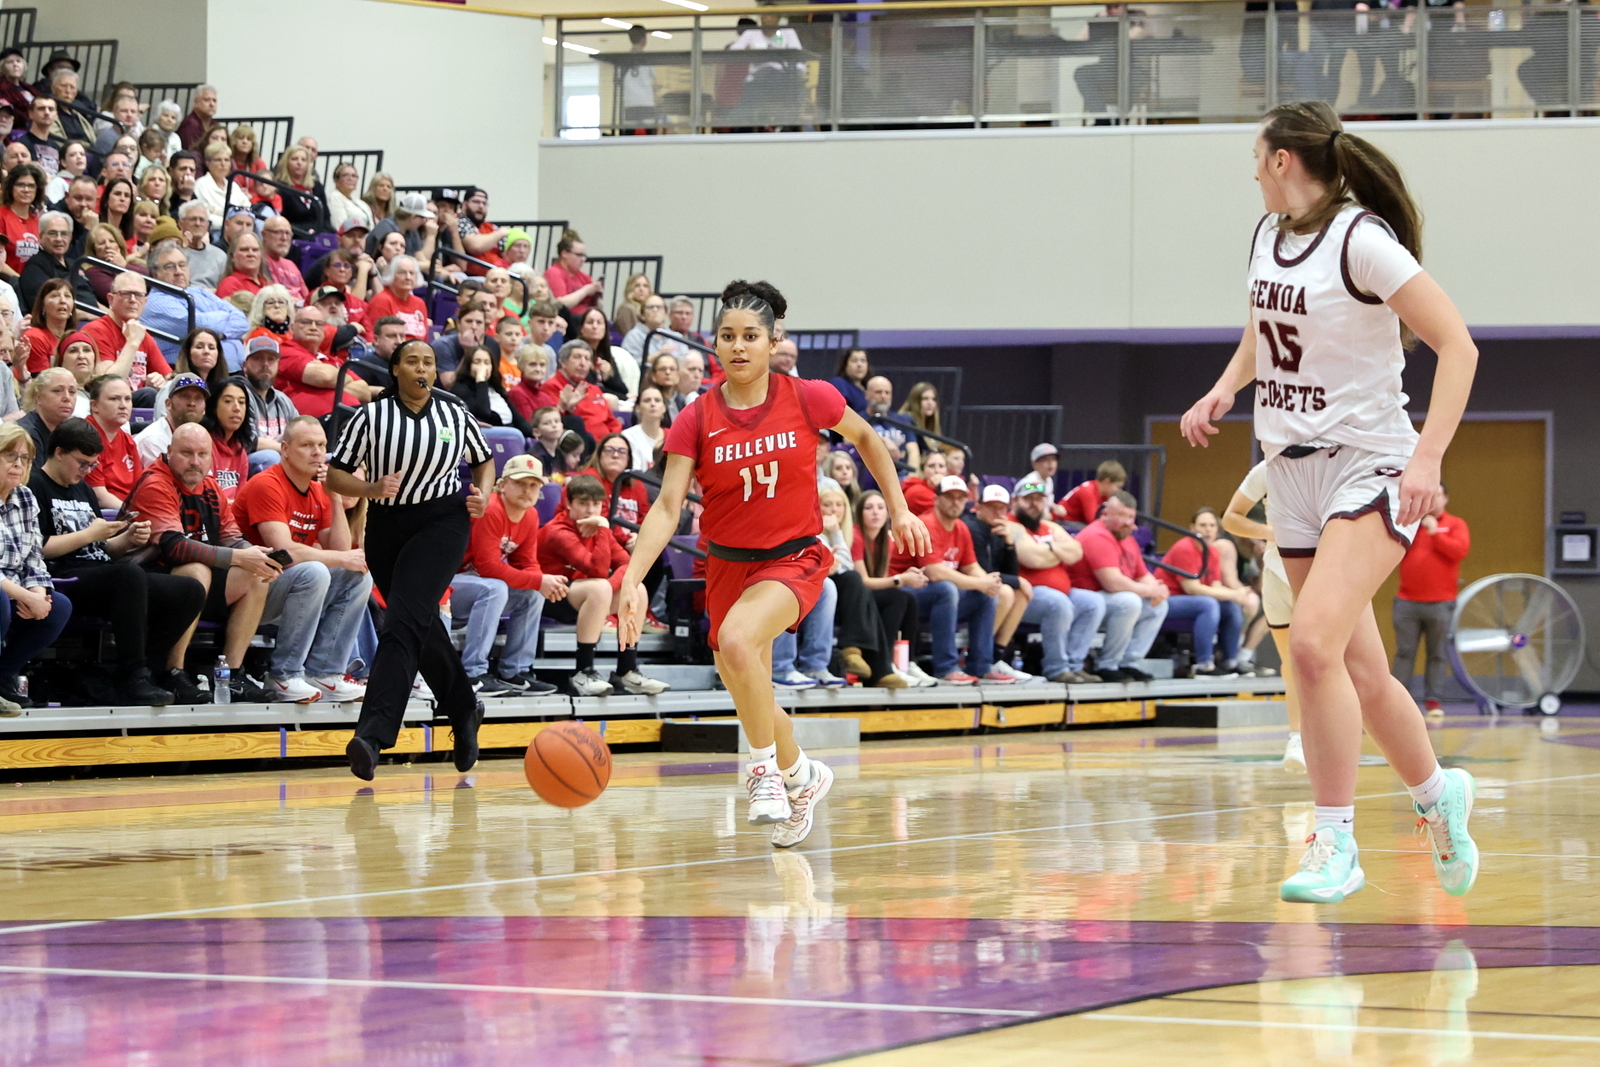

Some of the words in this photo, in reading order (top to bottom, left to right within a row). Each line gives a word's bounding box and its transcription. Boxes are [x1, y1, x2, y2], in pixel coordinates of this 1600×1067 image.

[1250, 279, 1308, 315] GENOA
[1258, 319, 1304, 374] 15
[714, 430, 798, 464] BELLEVUE
[739, 460, 779, 502] 14
